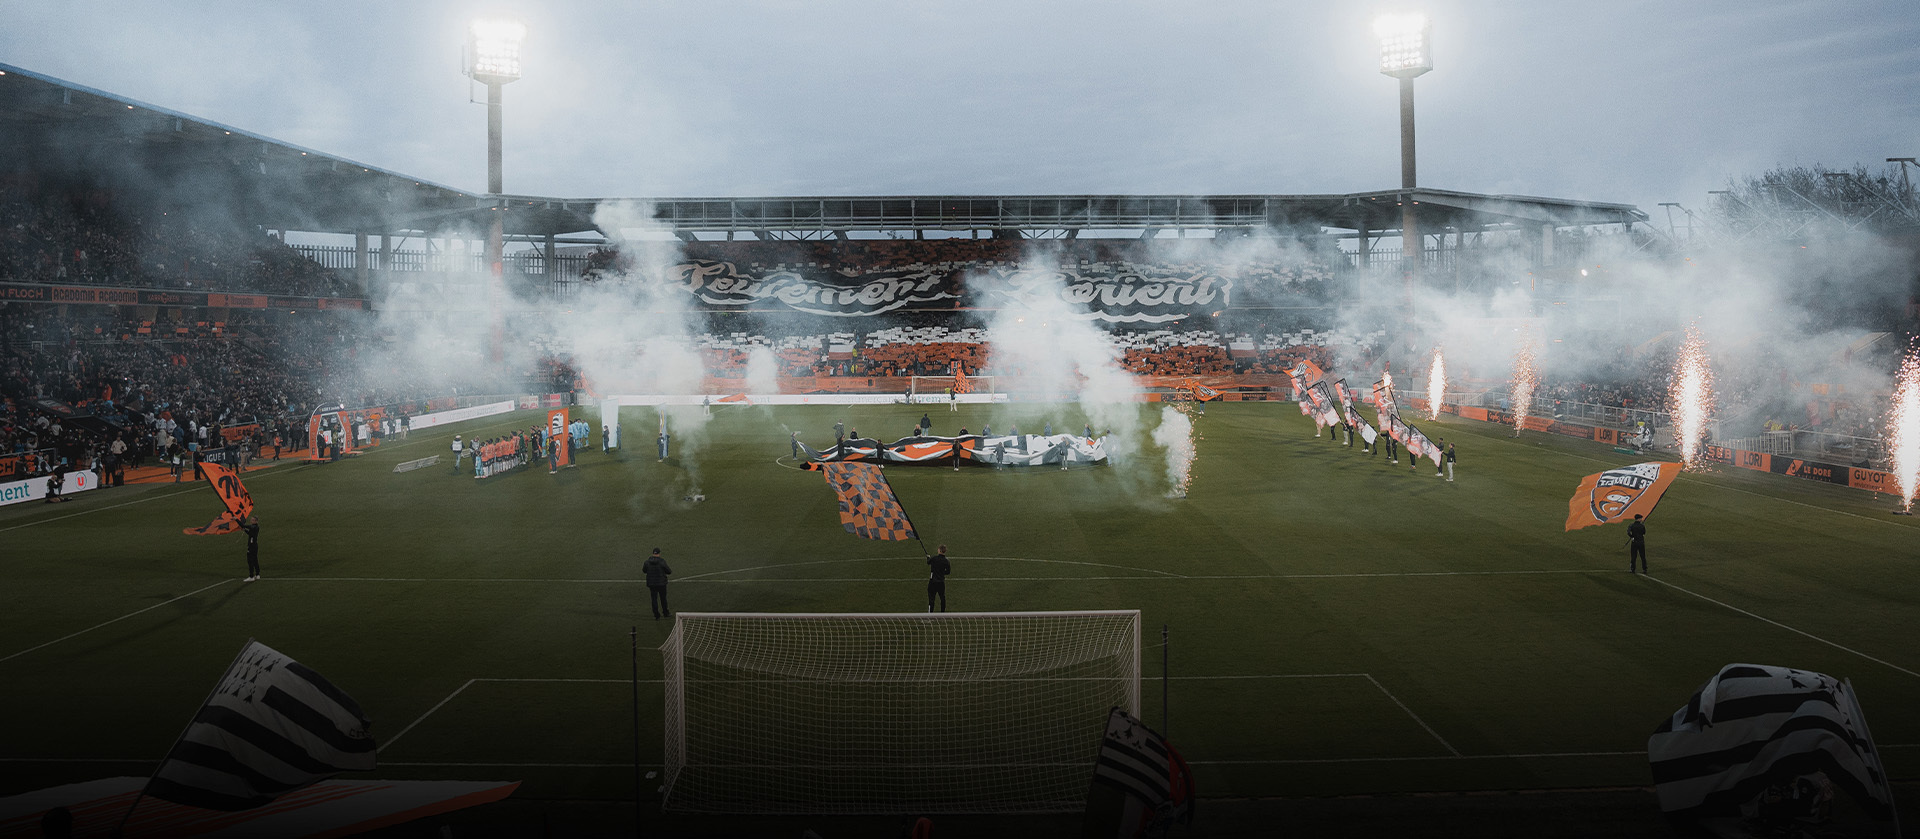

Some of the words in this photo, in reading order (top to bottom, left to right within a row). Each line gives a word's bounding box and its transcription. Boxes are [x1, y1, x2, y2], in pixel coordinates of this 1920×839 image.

[8, 288, 43, 299] FLOCH
[54, 289, 95, 301] ACADOMIA
[100, 290, 137, 303] ACADOMIA
[1744, 452, 1762, 467] LORI
[1804, 466, 1811, 474] LE
[77, 476, 85, 487] U
[1854, 470, 1886, 484] GUYOT
